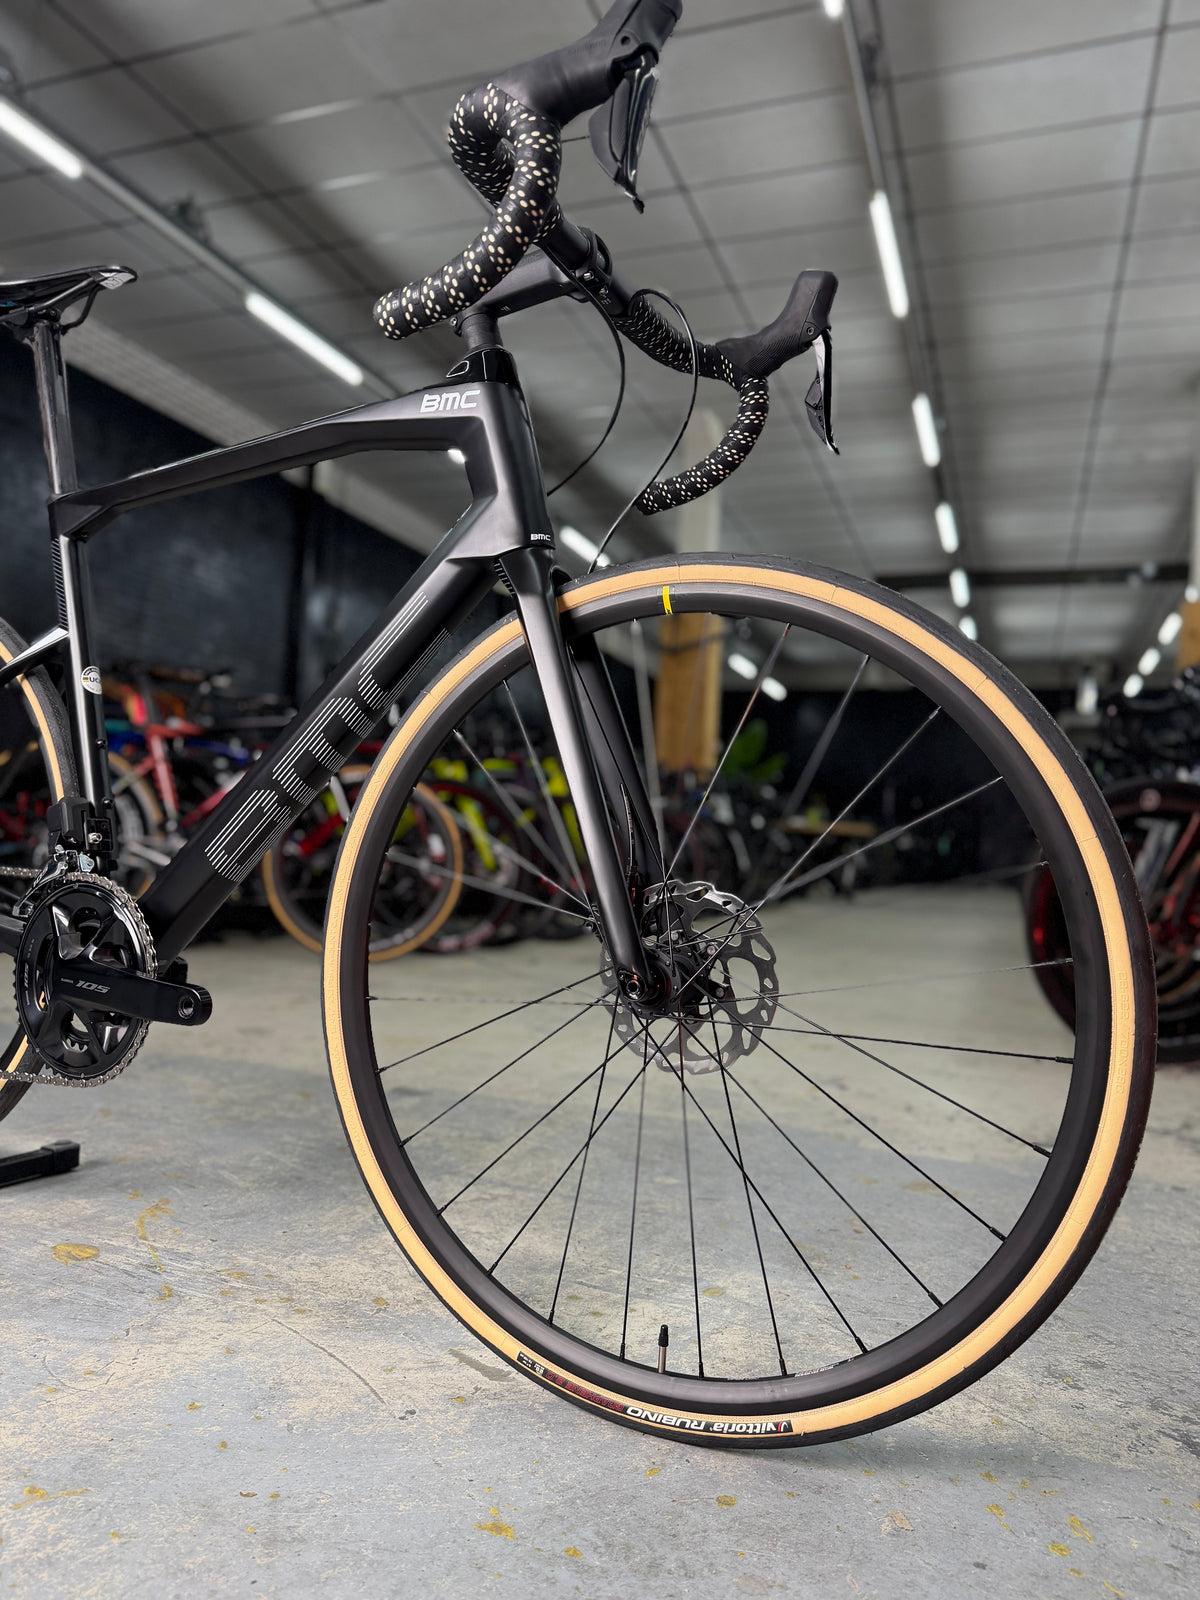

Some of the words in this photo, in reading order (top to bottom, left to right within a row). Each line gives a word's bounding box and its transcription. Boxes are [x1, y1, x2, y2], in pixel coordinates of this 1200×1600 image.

[420, 390, 481, 413] BMC
[530, 533, 551, 542] BMC
[204, 591, 450, 883] BMC
[75, 980, 111, 994] 105
[626, 1406, 706, 1431] RUBINO
[713, 1421, 777, 1434] vittoria
